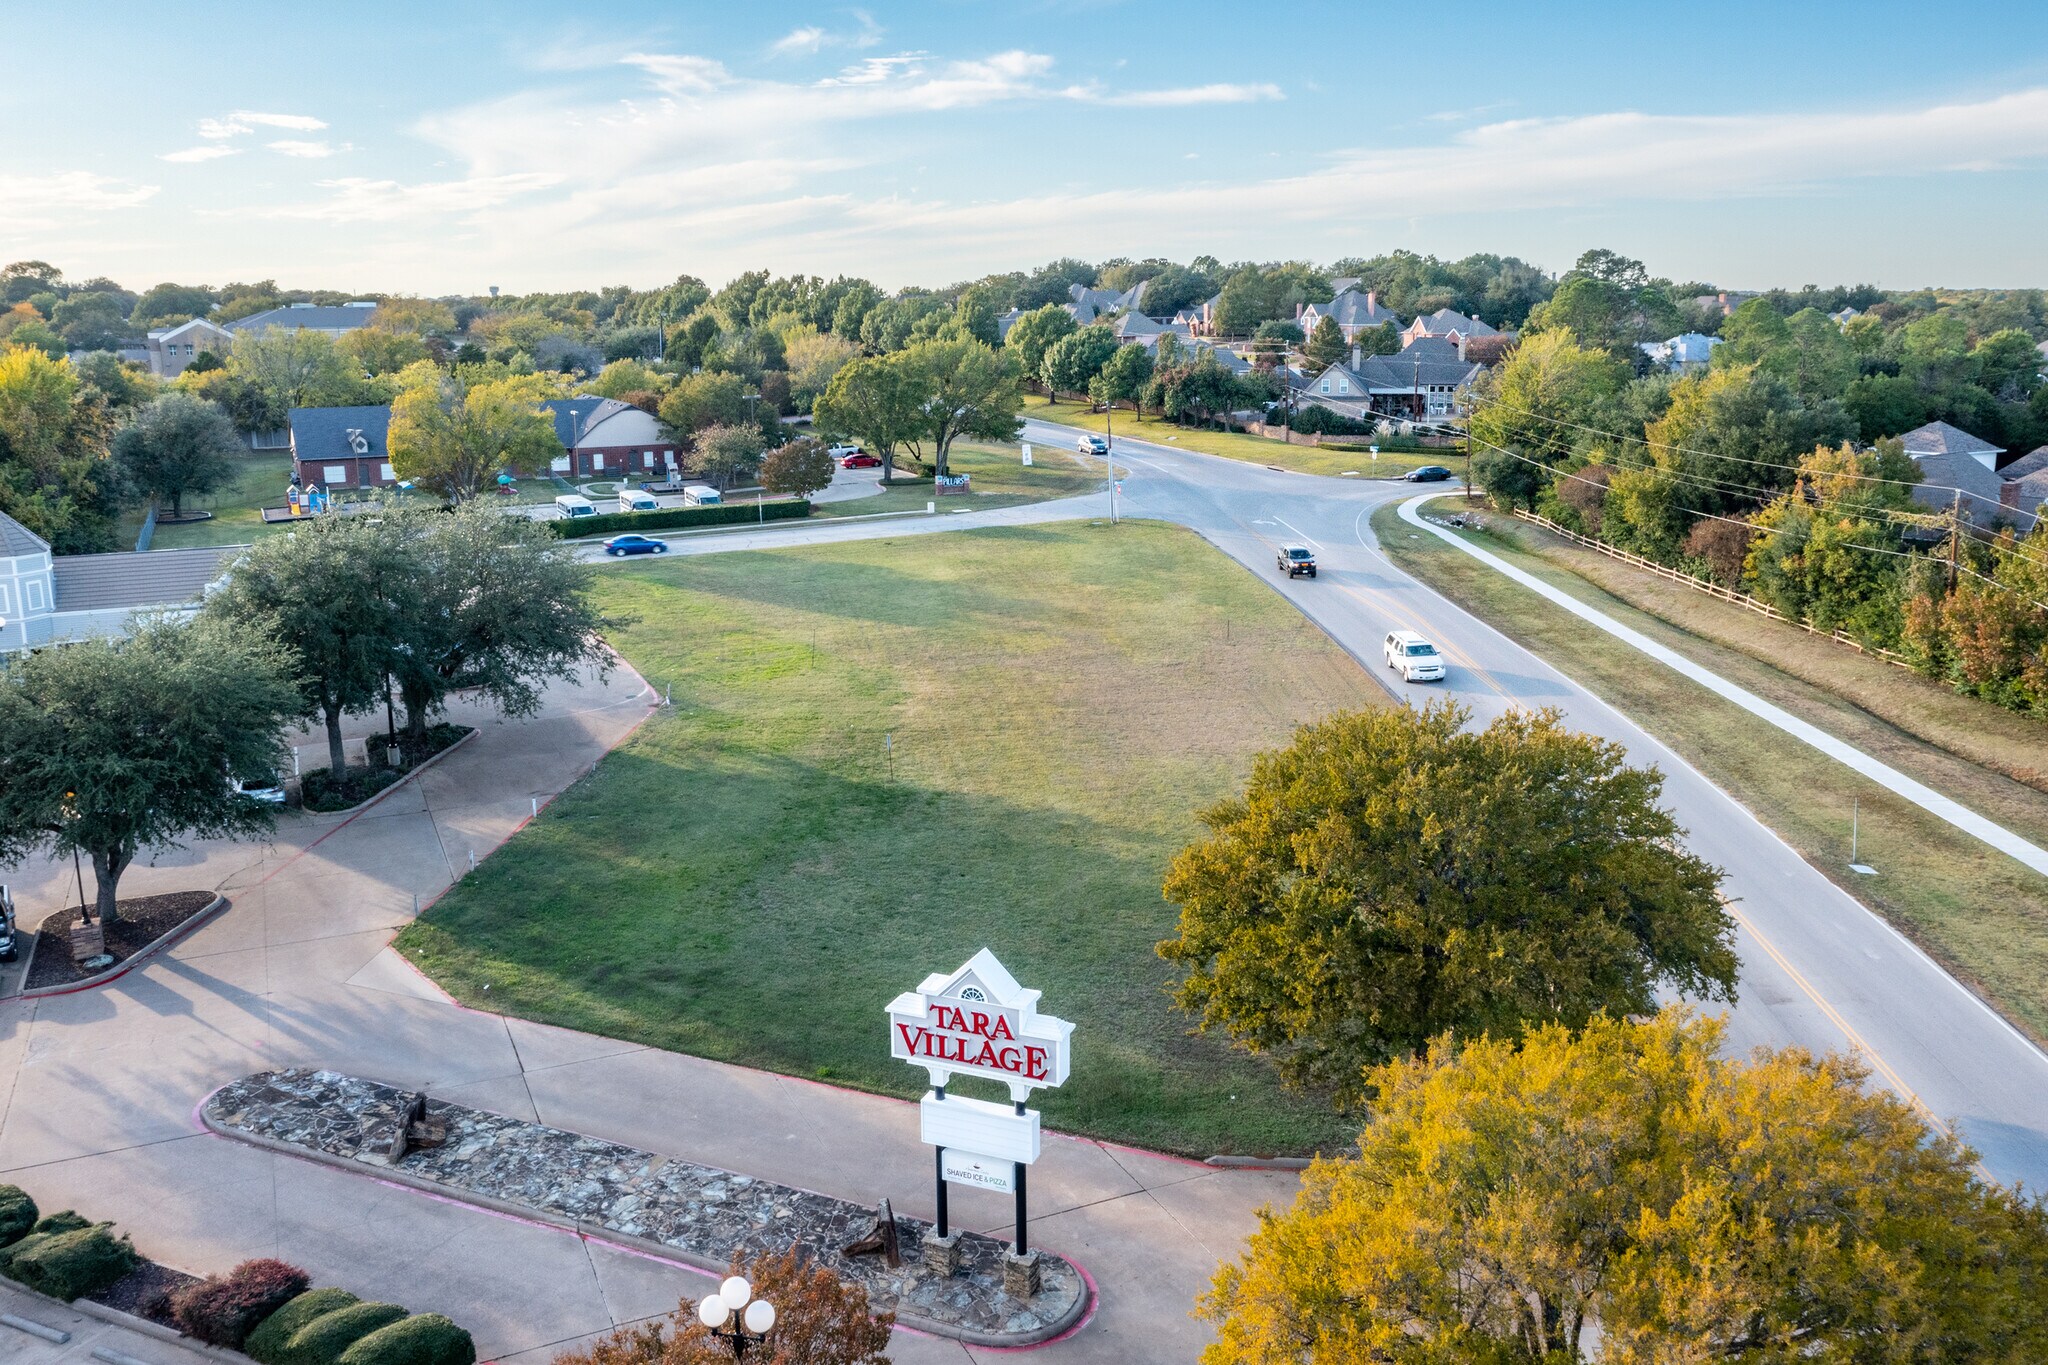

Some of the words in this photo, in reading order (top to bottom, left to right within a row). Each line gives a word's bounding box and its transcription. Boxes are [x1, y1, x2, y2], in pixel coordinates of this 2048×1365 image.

[929, 1004, 1016, 1041] TARA
[896, 1023, 1050, 1081] VILLAGE
[946, 1167, 972, 1179] SHAVED
[973, 1174, 983, 1182] ICE
[989, 1177, 1007, 1187] PIZZA
